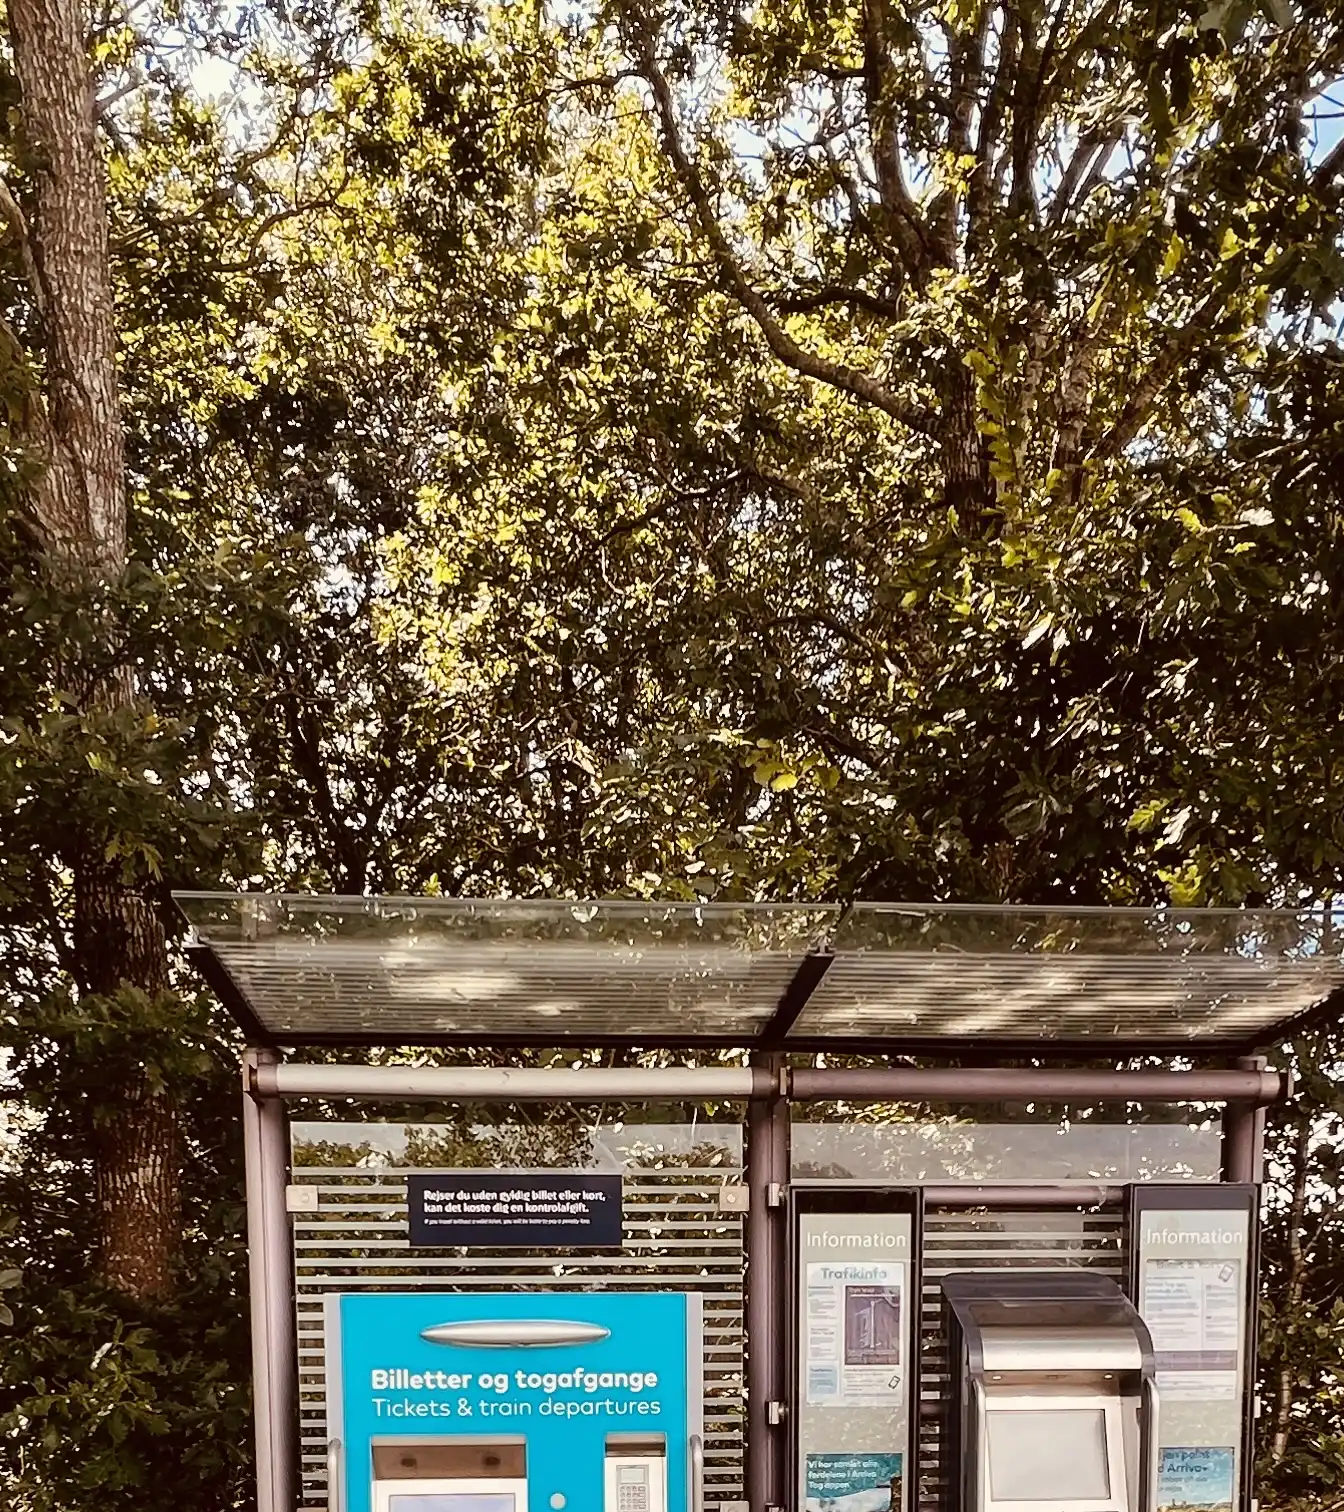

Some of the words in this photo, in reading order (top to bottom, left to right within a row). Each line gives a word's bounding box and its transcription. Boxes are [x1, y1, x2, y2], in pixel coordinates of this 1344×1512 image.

[424, 1190, 455, 1202] Rejser
[456, 1190, 471, 1200] du
[471, 1190, 497, 1200] uden
[499, 1190, 530, 1202] gyldig
[531, 1189, 557, 1200] billet
[558, 1189, 581, 1200] eller
[582, 1189, 606, 1202] kort,
[424, 1202, 443, 1212] kan
[444, 1202, 462, 1212] det
[463, 1202, 491, 1212] koste
[492, 1202, 509, 1214] dig
[510, 1204, 524, 1212] en
[525, 1202, 590, 1214] kontrolafgift.
[807, 1231, 906, 1248] Information
[1146, 1228, 1243, 1245] Information
[820, 1267, 888, 1281] Trafikinfo
[371, 1369, 472, 1390] Billetter
[478, 1372, 509, 1393] og
[515, 1367, 658, 1393] togafgange
[372, 1398, 451, 1417] Tickets
[457, 1397, 473, 1417] &
[479, 1397, 531, 1417] train
[539, 1397, 661, 1419] departures
